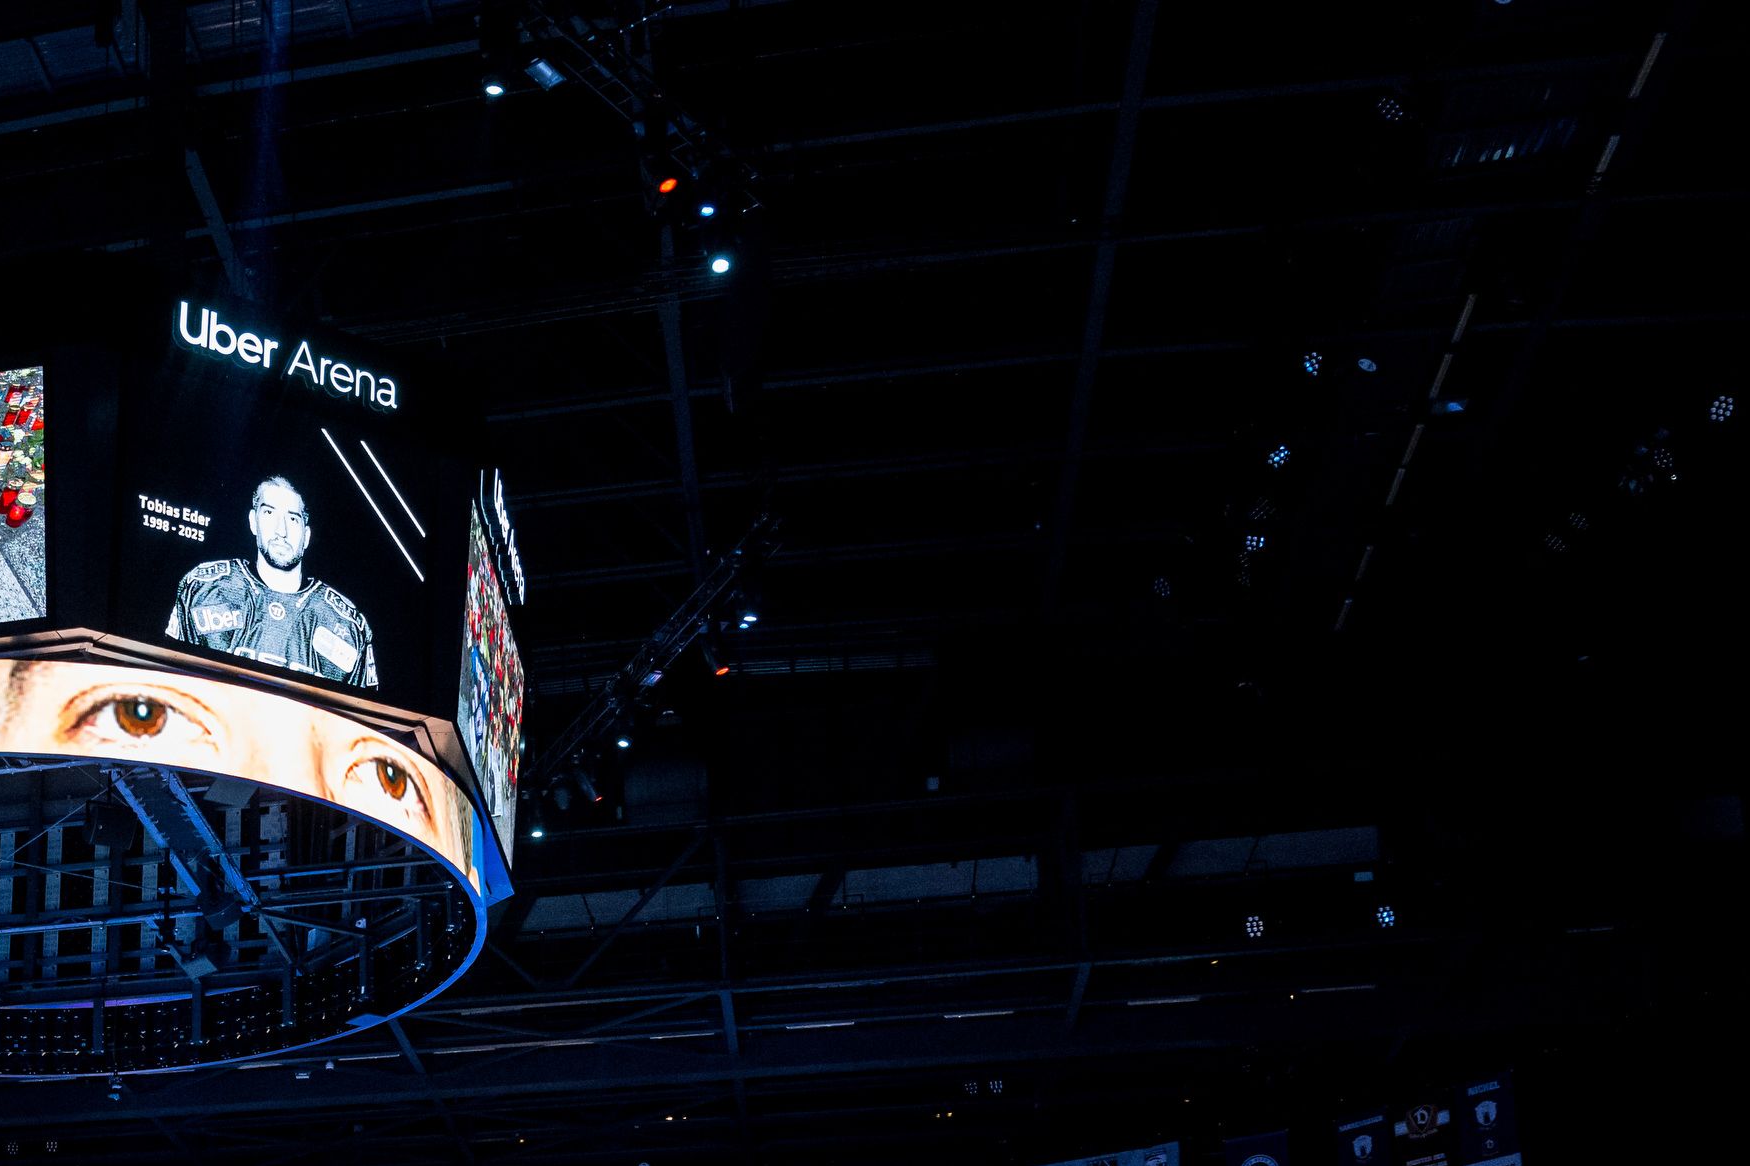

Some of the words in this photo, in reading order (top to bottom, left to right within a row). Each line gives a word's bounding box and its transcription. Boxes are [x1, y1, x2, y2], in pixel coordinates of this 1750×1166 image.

[179, 301, 279, 369] Uber
[288, 341, 398, 410] Arena
[139, 494, 180, 518] Tobias
[182, 508, 211, 527] Eder
[143, 514, 170, 533] 1998
[178, 523, 205, 542] 2025
[193, 608, 241, 633] Uber
